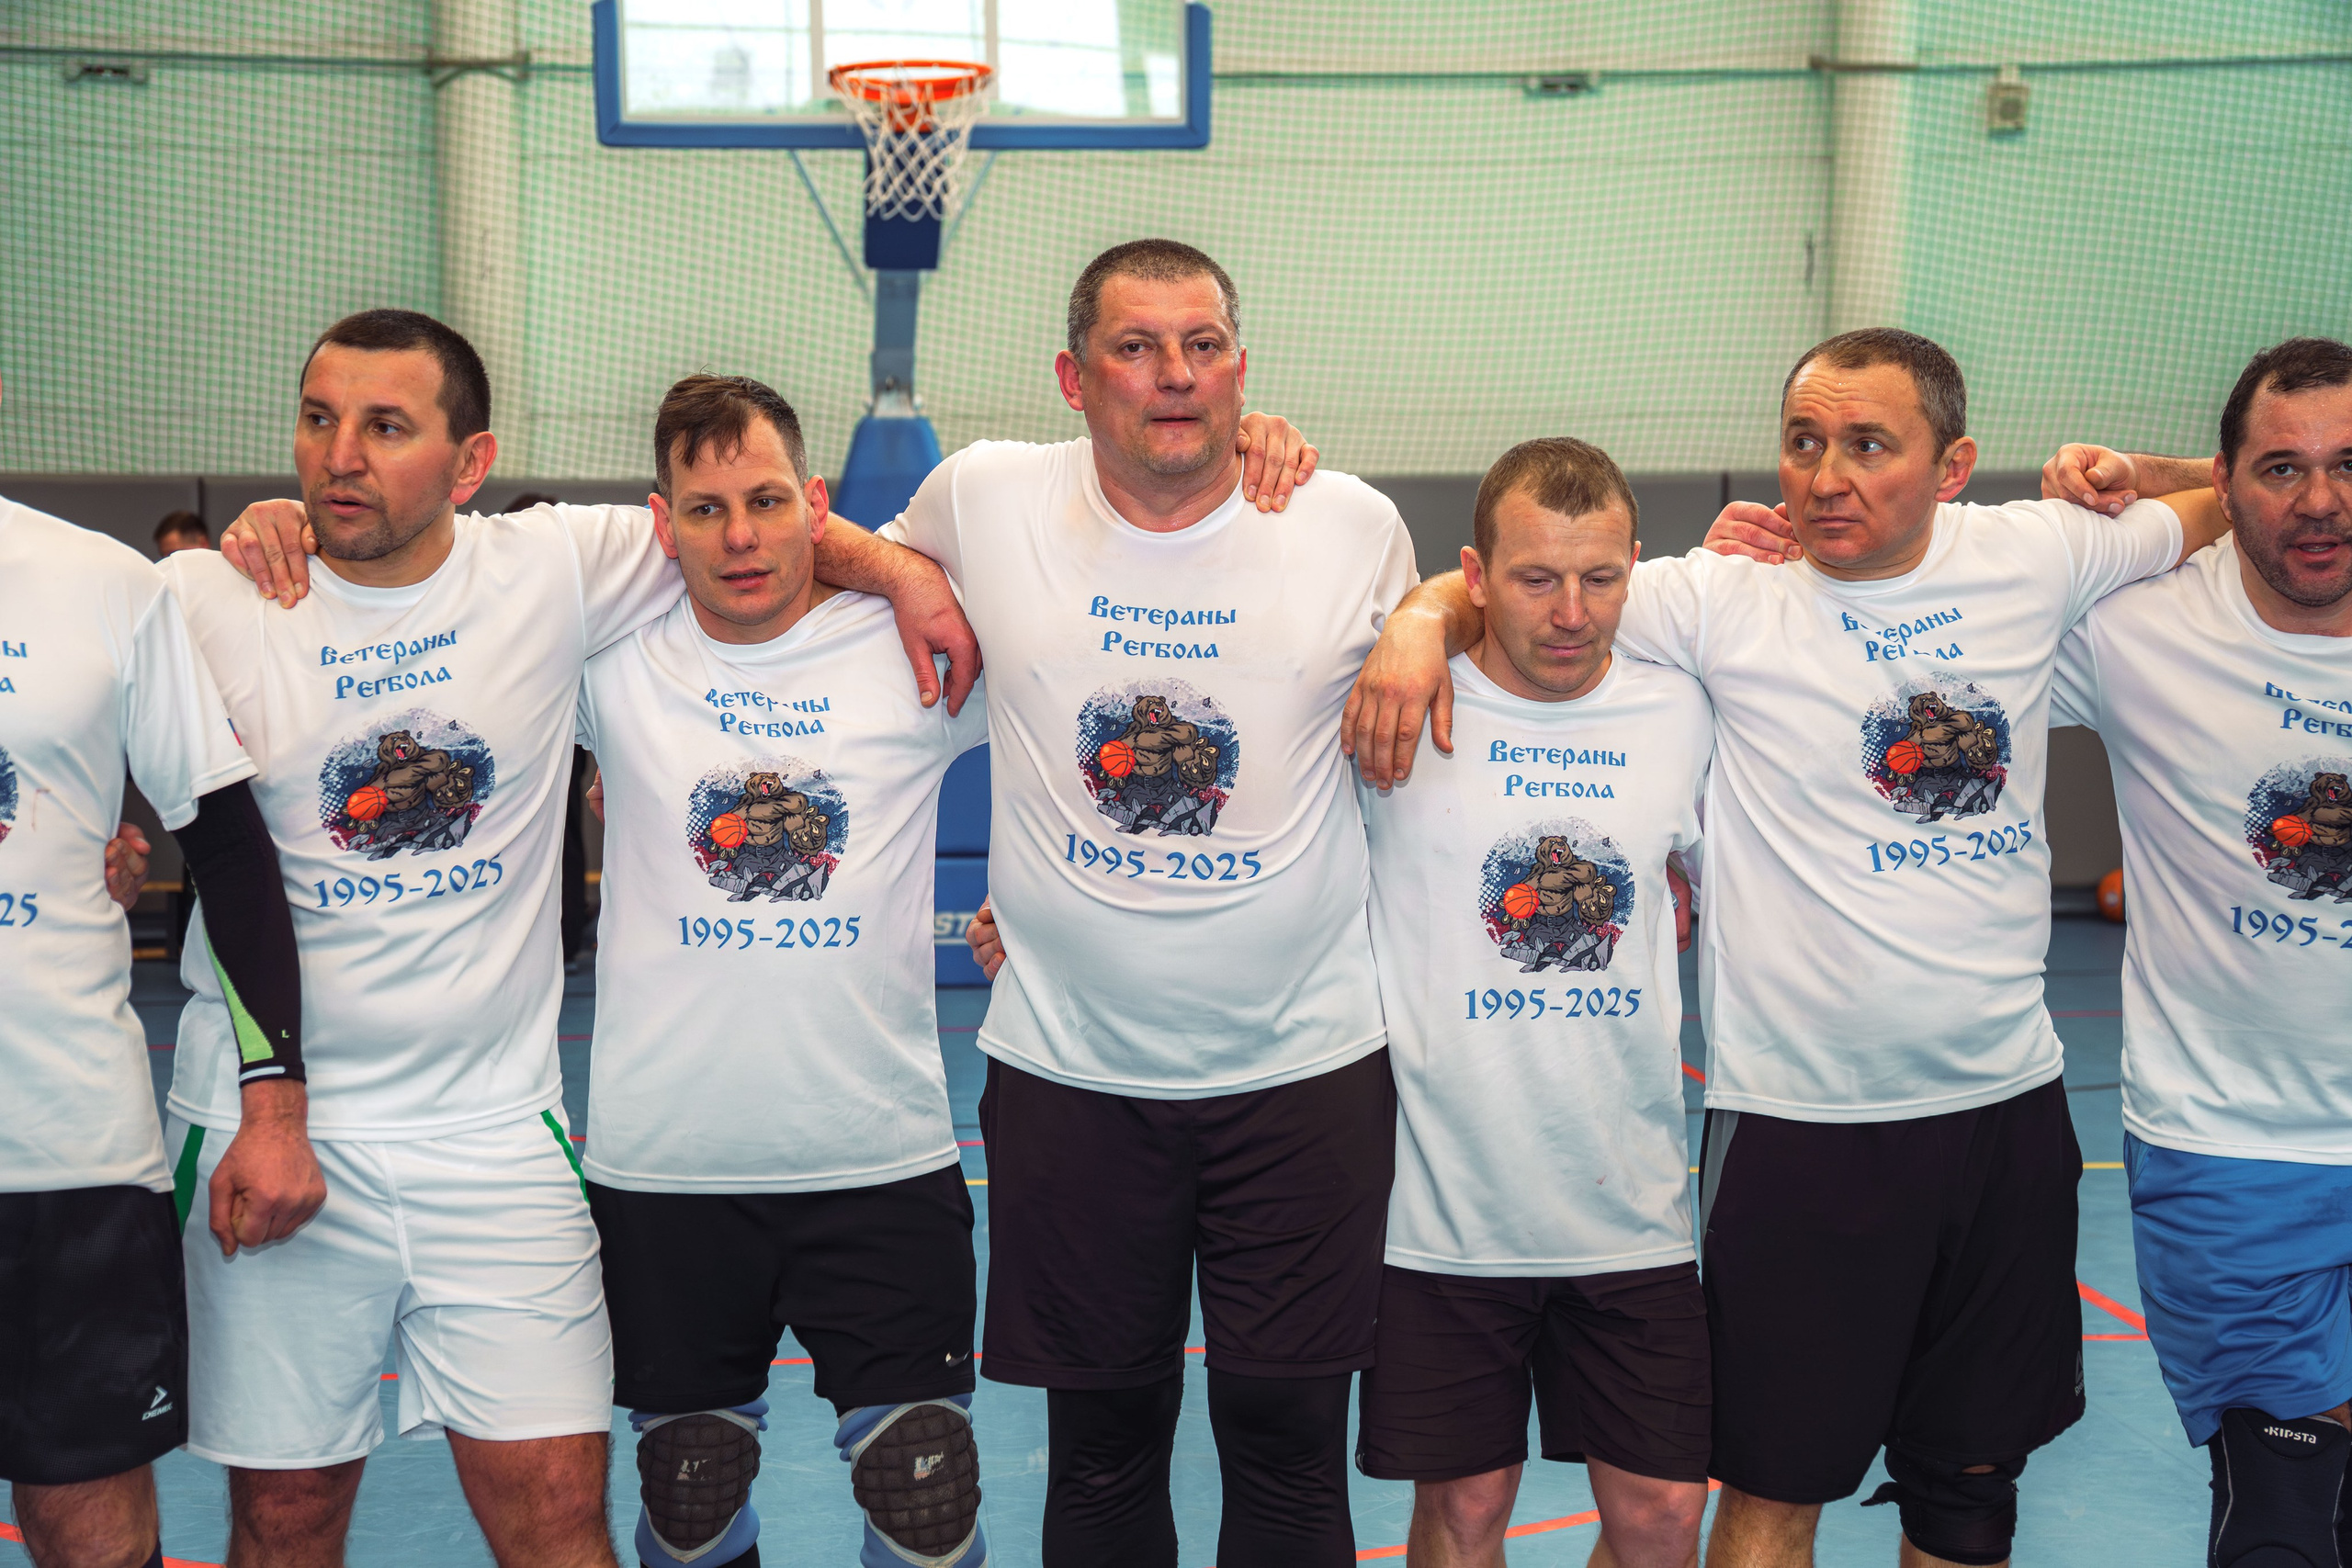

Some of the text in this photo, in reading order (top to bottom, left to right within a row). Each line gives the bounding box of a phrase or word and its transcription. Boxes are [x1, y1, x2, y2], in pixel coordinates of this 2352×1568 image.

[1088, 595, 1237, 632] Ветераны
[320, 629, 458, 665] Ветераны
[1101, 630, 1219, 660] Регбола
[334, 666, 453, 700] Регбола
[719, 712, 825, 738] Регбола
[1487, 739, 1626, 771] Ветераны
[1503, 773, 1615, 798] Регбола
[1065, 833, 1261, 881] 1995-2025
[1866, 819, 2032, 873] 1995-2025
[313, 854, 503, 908] 1995-2025
[678, 916, 861, 950] 1995-2025
[1464, 987, 1643, 1020] 1995-2025
